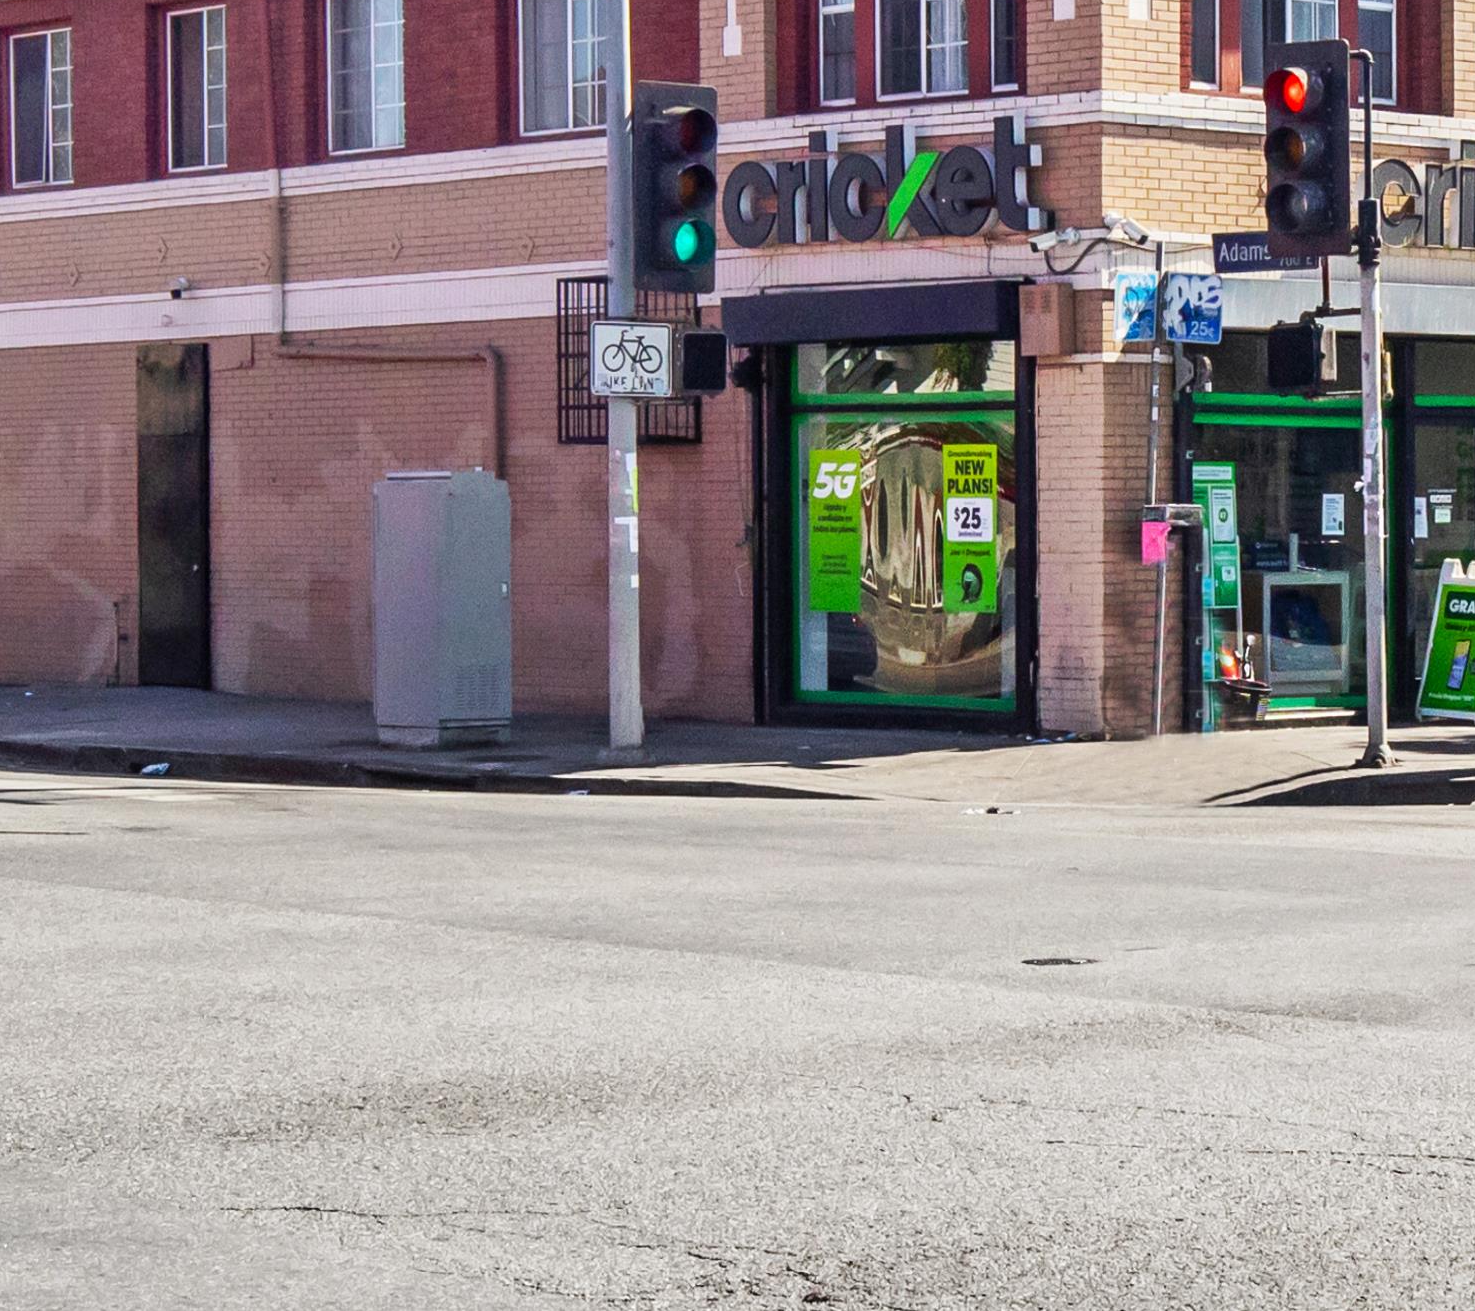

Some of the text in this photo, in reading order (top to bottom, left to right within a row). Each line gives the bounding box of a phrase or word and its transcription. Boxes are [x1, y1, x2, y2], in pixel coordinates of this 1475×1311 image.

[723, 116, 1032, 248] cricket
[954, 459, 985, 476] NEW
[812, 462, 858, 499] 5G
[947, 478, 994, 494] PLANS!
[954, 506, 982, 530] $25
